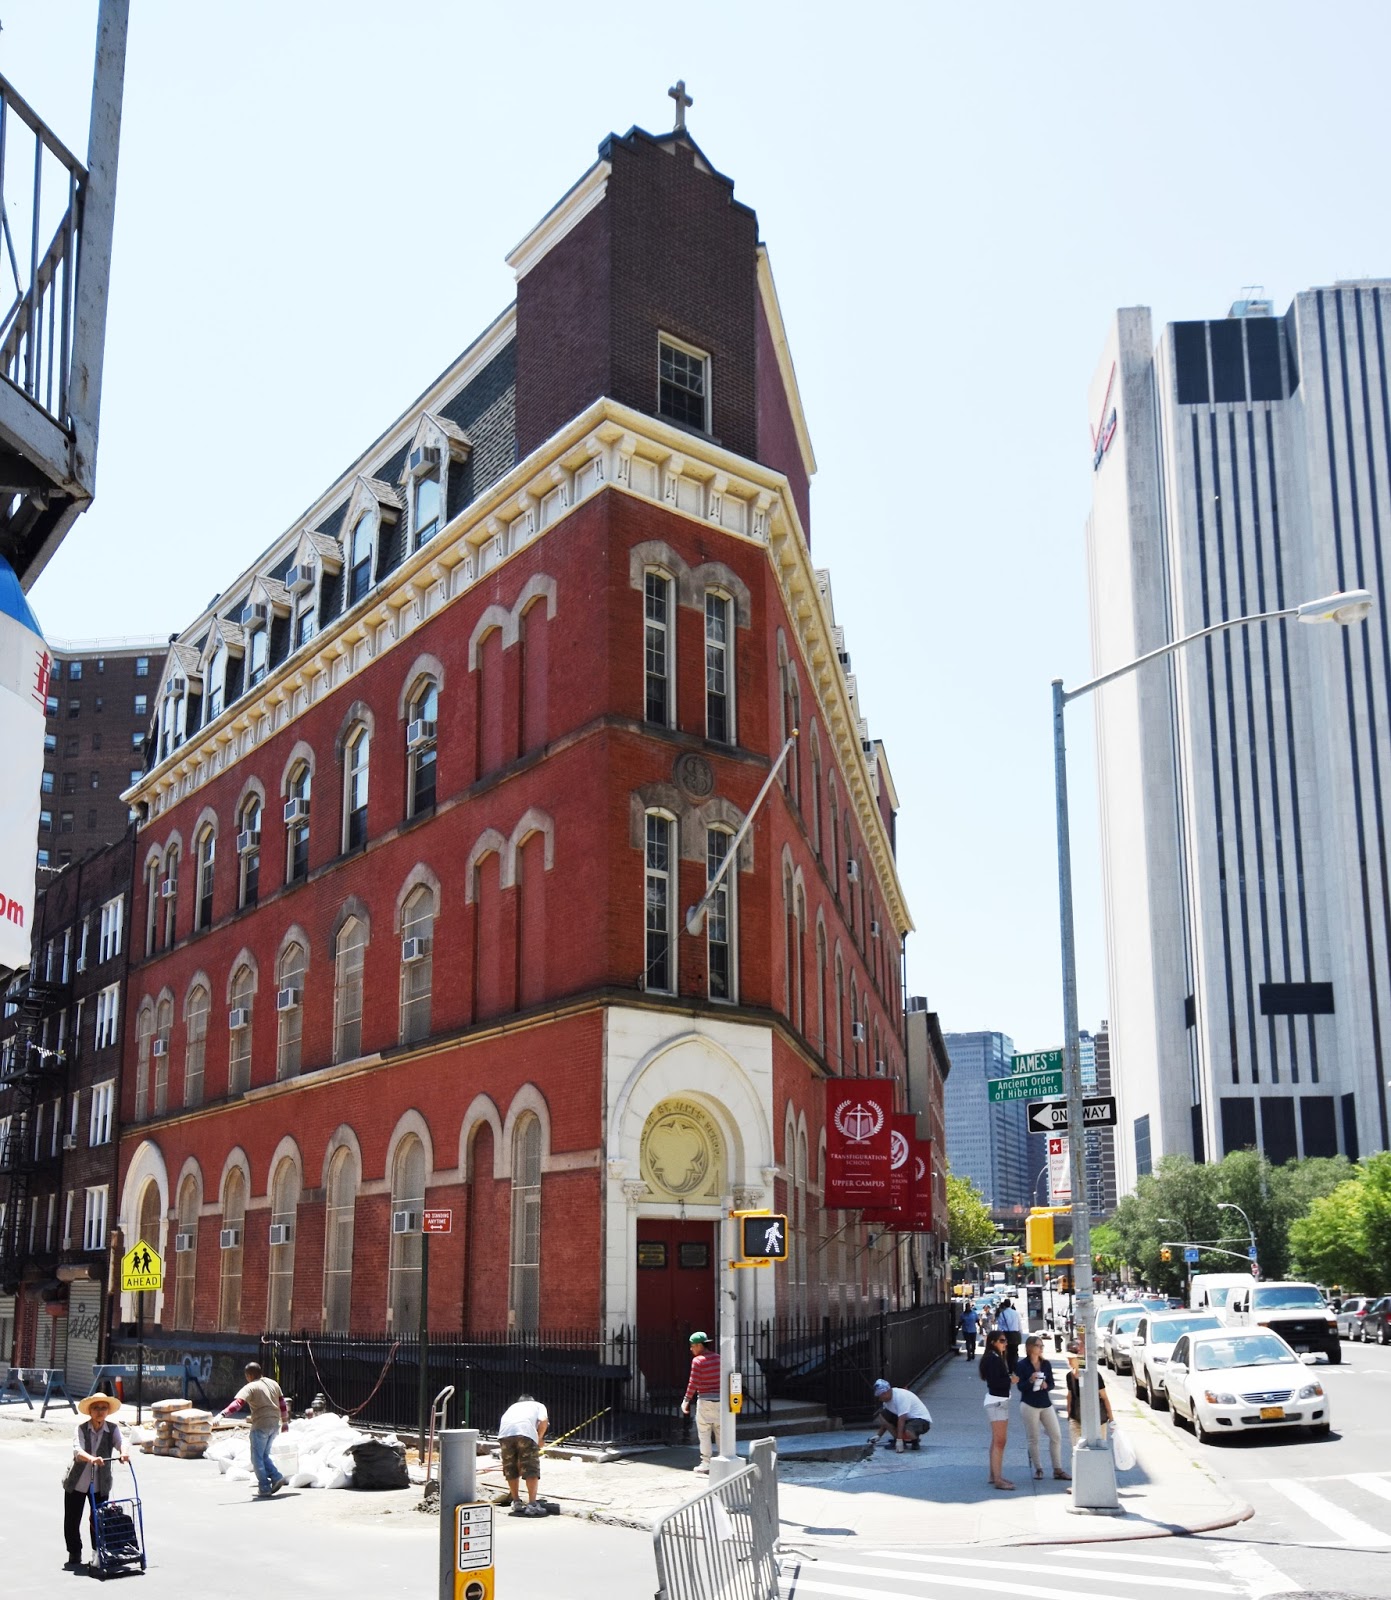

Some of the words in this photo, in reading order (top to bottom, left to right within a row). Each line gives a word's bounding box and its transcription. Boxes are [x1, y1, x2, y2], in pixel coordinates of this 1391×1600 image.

[1012, 1053, 1047, 1074] JAMES
[1049, 1052, 1059, 1062] ST
[997, 1077, 1029, 1090] Ancient
[1031, 1075, 1055, 1086] Order
[995, 1089, 1004, 1100] of
[1008, 1085, 1059, 1098] Hibernians
[1051, 1110, 1068, 1122] ON
[1083, 1106, 1107, 1119] WAY
[855, 1180, 885, 1188] CAMPUS
[126, 1276, 158, 1287] AHEAD
